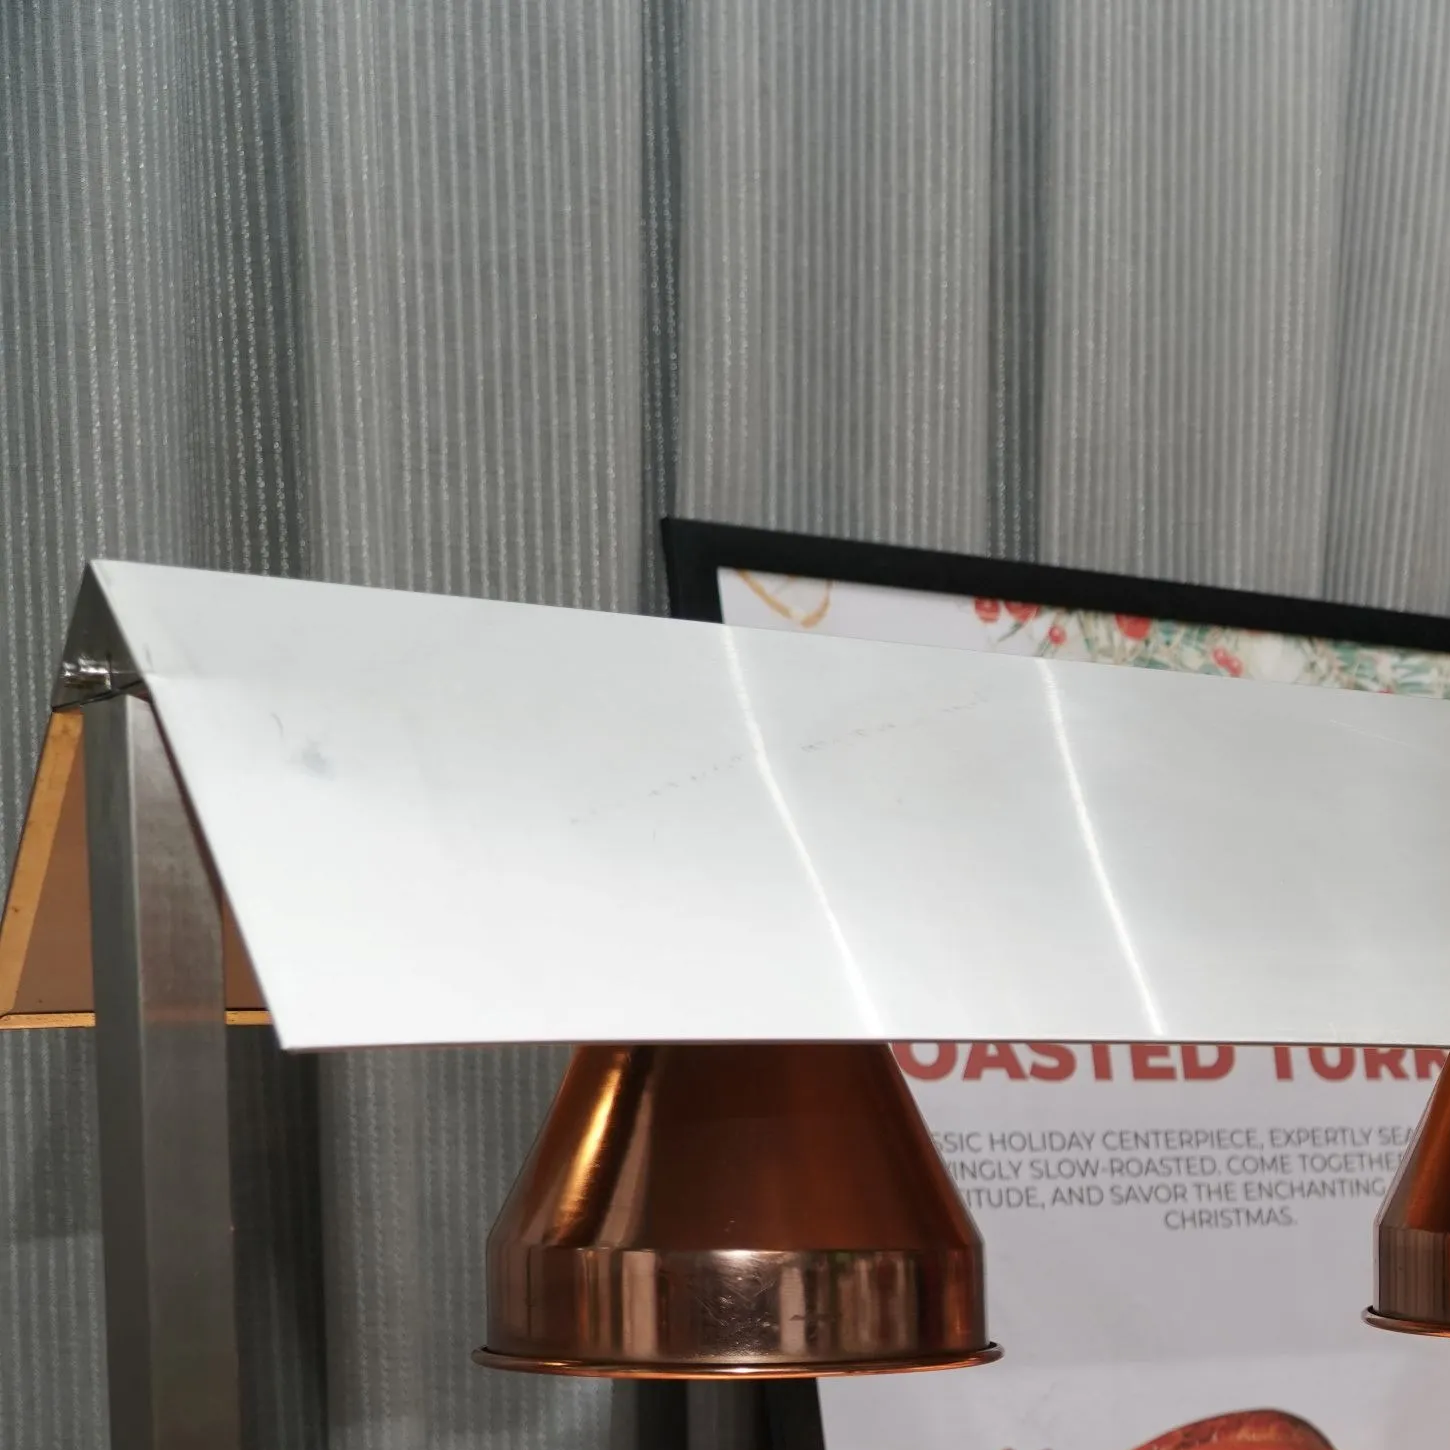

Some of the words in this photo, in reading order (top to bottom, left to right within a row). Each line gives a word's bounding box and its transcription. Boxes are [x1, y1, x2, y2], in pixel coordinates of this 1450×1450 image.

[990, 1130, 1095, 1153] HOLIDAY
[1102, 1127, 1264, 1152] CENTERPIECE,
[1270, 1126, 1373, 1149] EXPERTLY
[948, 1159, 1023, 1181] INGLY
[1030, 1155, 1222, 1180] SLOW-ROASTED.
[1227, 1154, 1292, 1176] COME
[1299, 1151, 1402, 1174] TOGETHE
[962, 1186, 1045, 1209] ITUDE,
[1051, 1186, 1104, 1207] AND
[1111, 1183, 1187, 1206] SAVOR
[1194, 1181, 1238, 1203] THE
[1244, 1178, 1386, 1202] ENCHANTING
[1165, 1206, 1298, 1231] CHRISTMAS.
